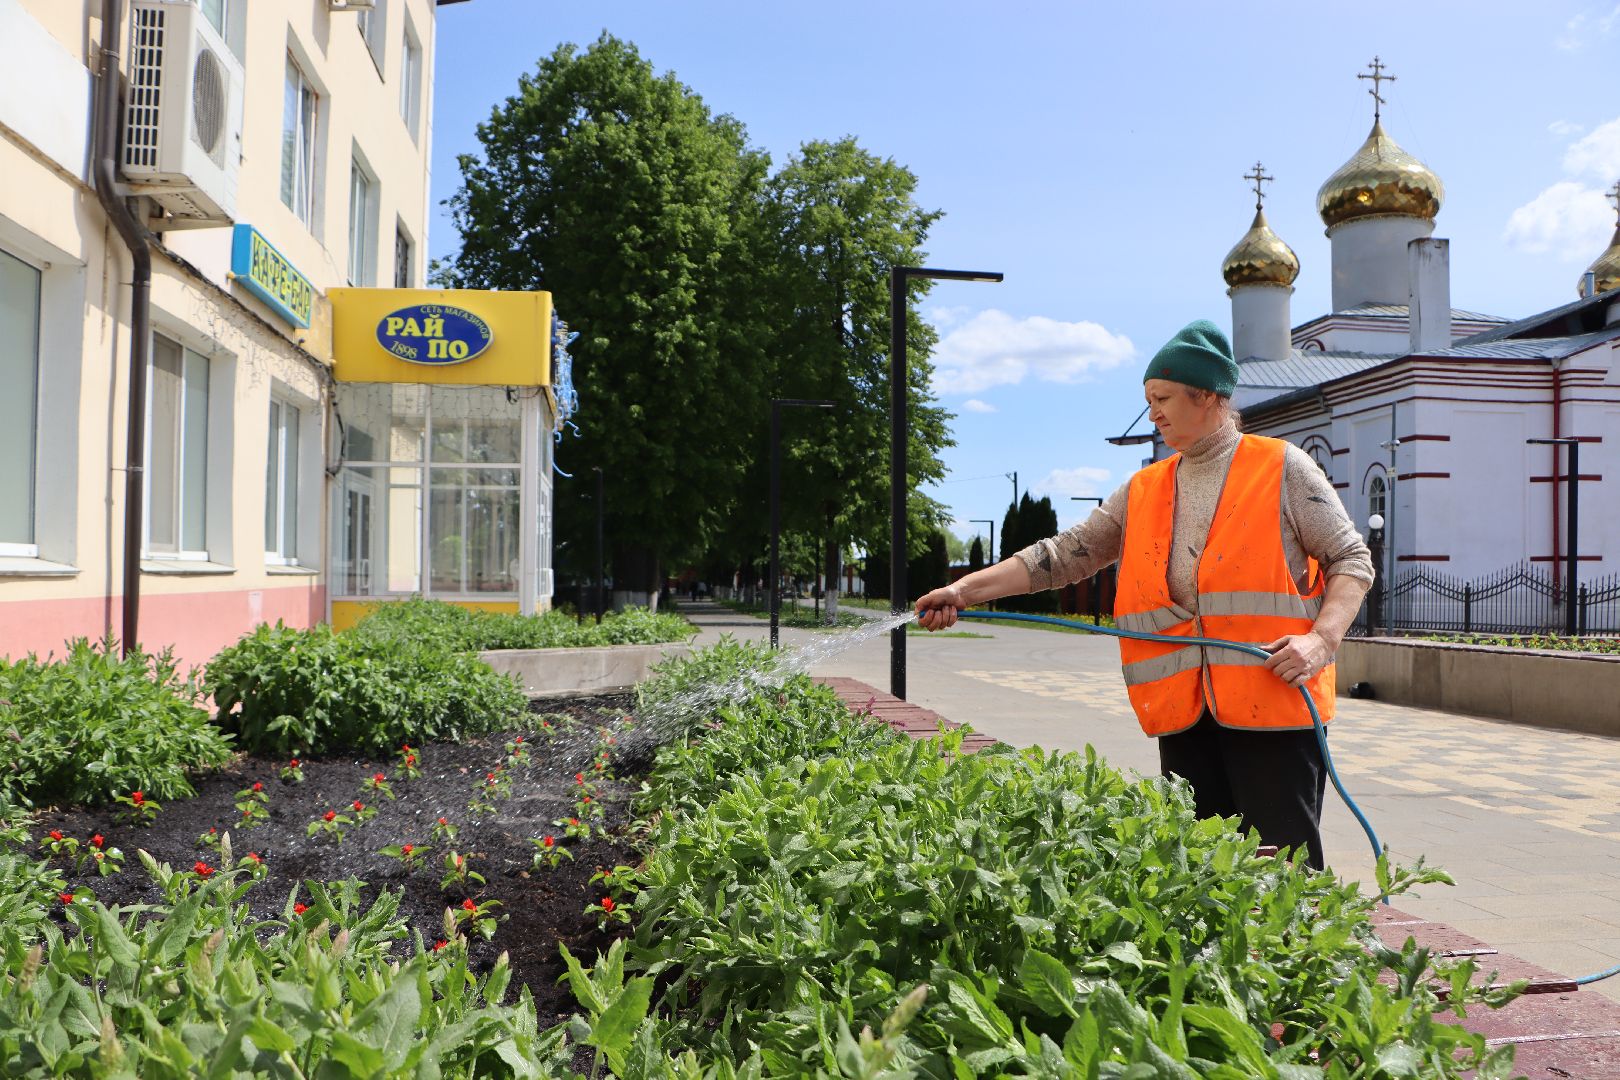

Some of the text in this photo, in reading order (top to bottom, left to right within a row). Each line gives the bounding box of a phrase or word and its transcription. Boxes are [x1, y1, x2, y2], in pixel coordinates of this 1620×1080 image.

[385, 314, 445, 338] РАЙ
[420, 305, 489, 339] СЕТЬ МАГАЗИНОВ
[390, 340, 418, 359] 1898
[427, 339, 469, 359] ПО
